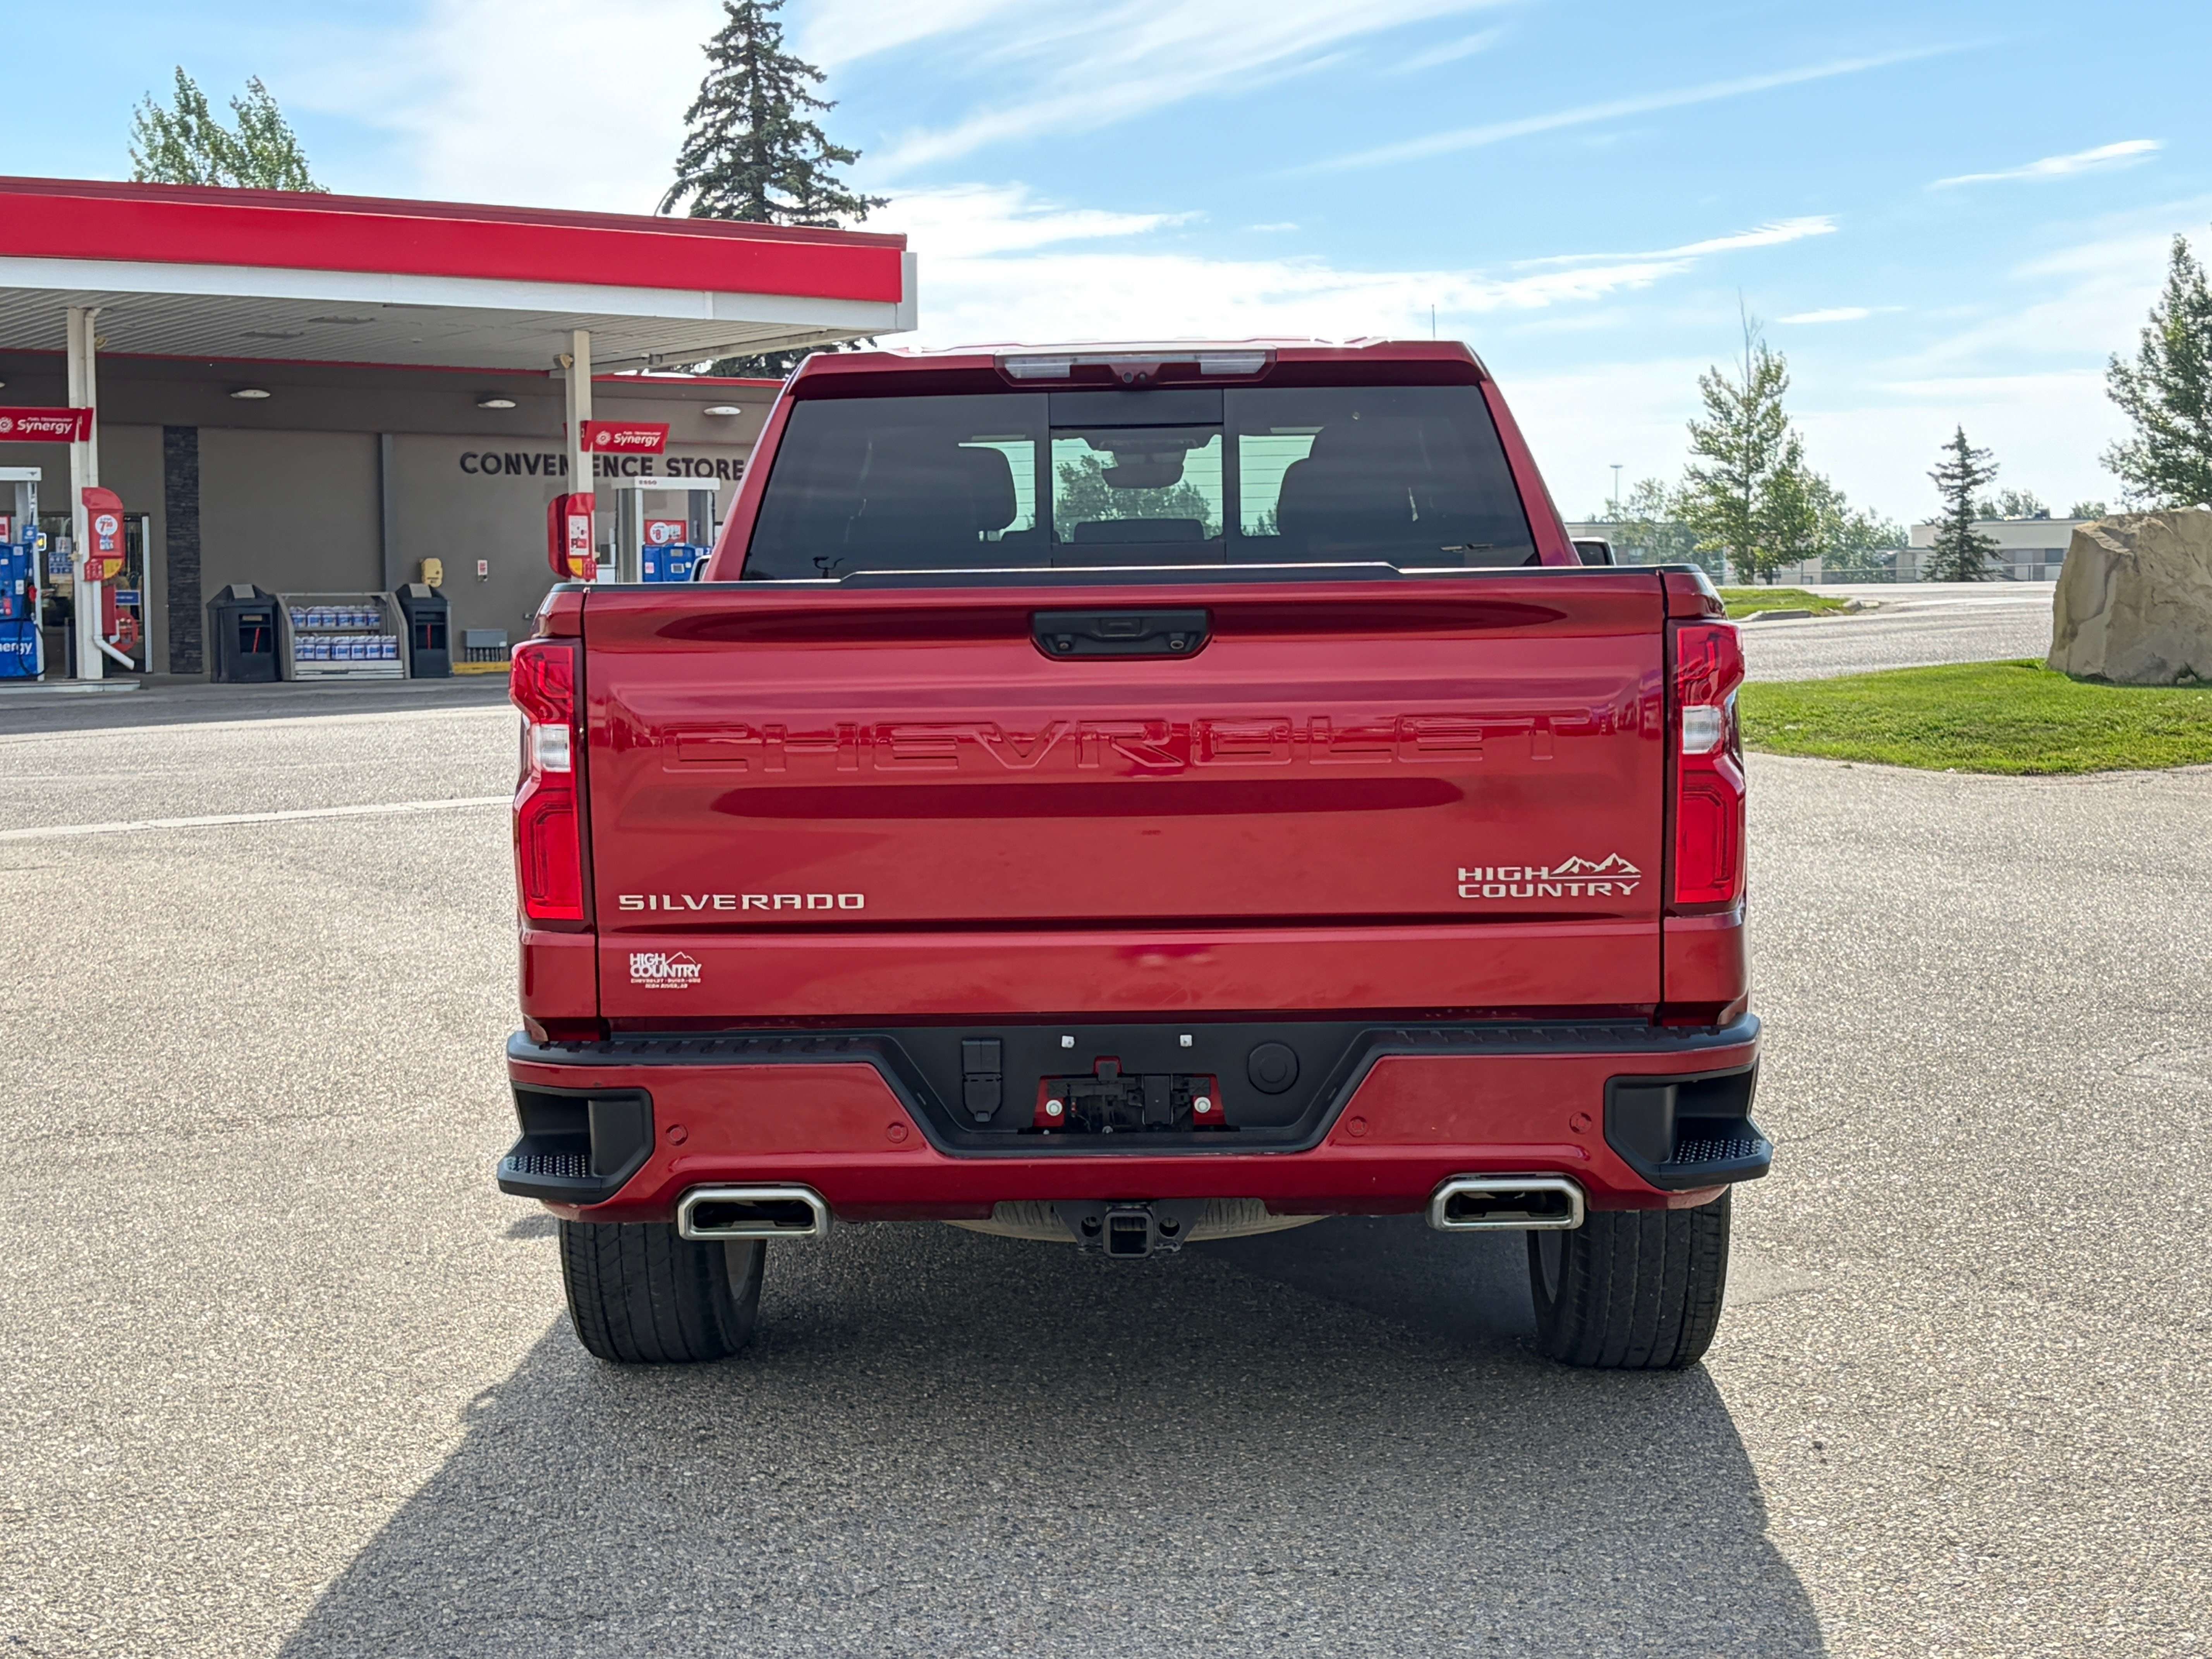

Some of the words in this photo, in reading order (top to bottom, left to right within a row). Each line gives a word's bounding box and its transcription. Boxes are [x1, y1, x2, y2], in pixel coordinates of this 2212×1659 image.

[17, 419, 72, 434] Synergy
[613, 433, 660, 447] Synergy
[460, 451, 653, 477] CONVENENCE
[666, 457, 745, 481] STORE
[661, 708, 1591, 773] CHEVROLET
[1458, 867, 1549, 881] HIGH
[1458, 882, 1640, 898] COUNTRY
[618, 893, 865, 910] SILVERADO
[630, 953, 666, 965] HIGH
[630, 963, 702, 977] COUNTRY
